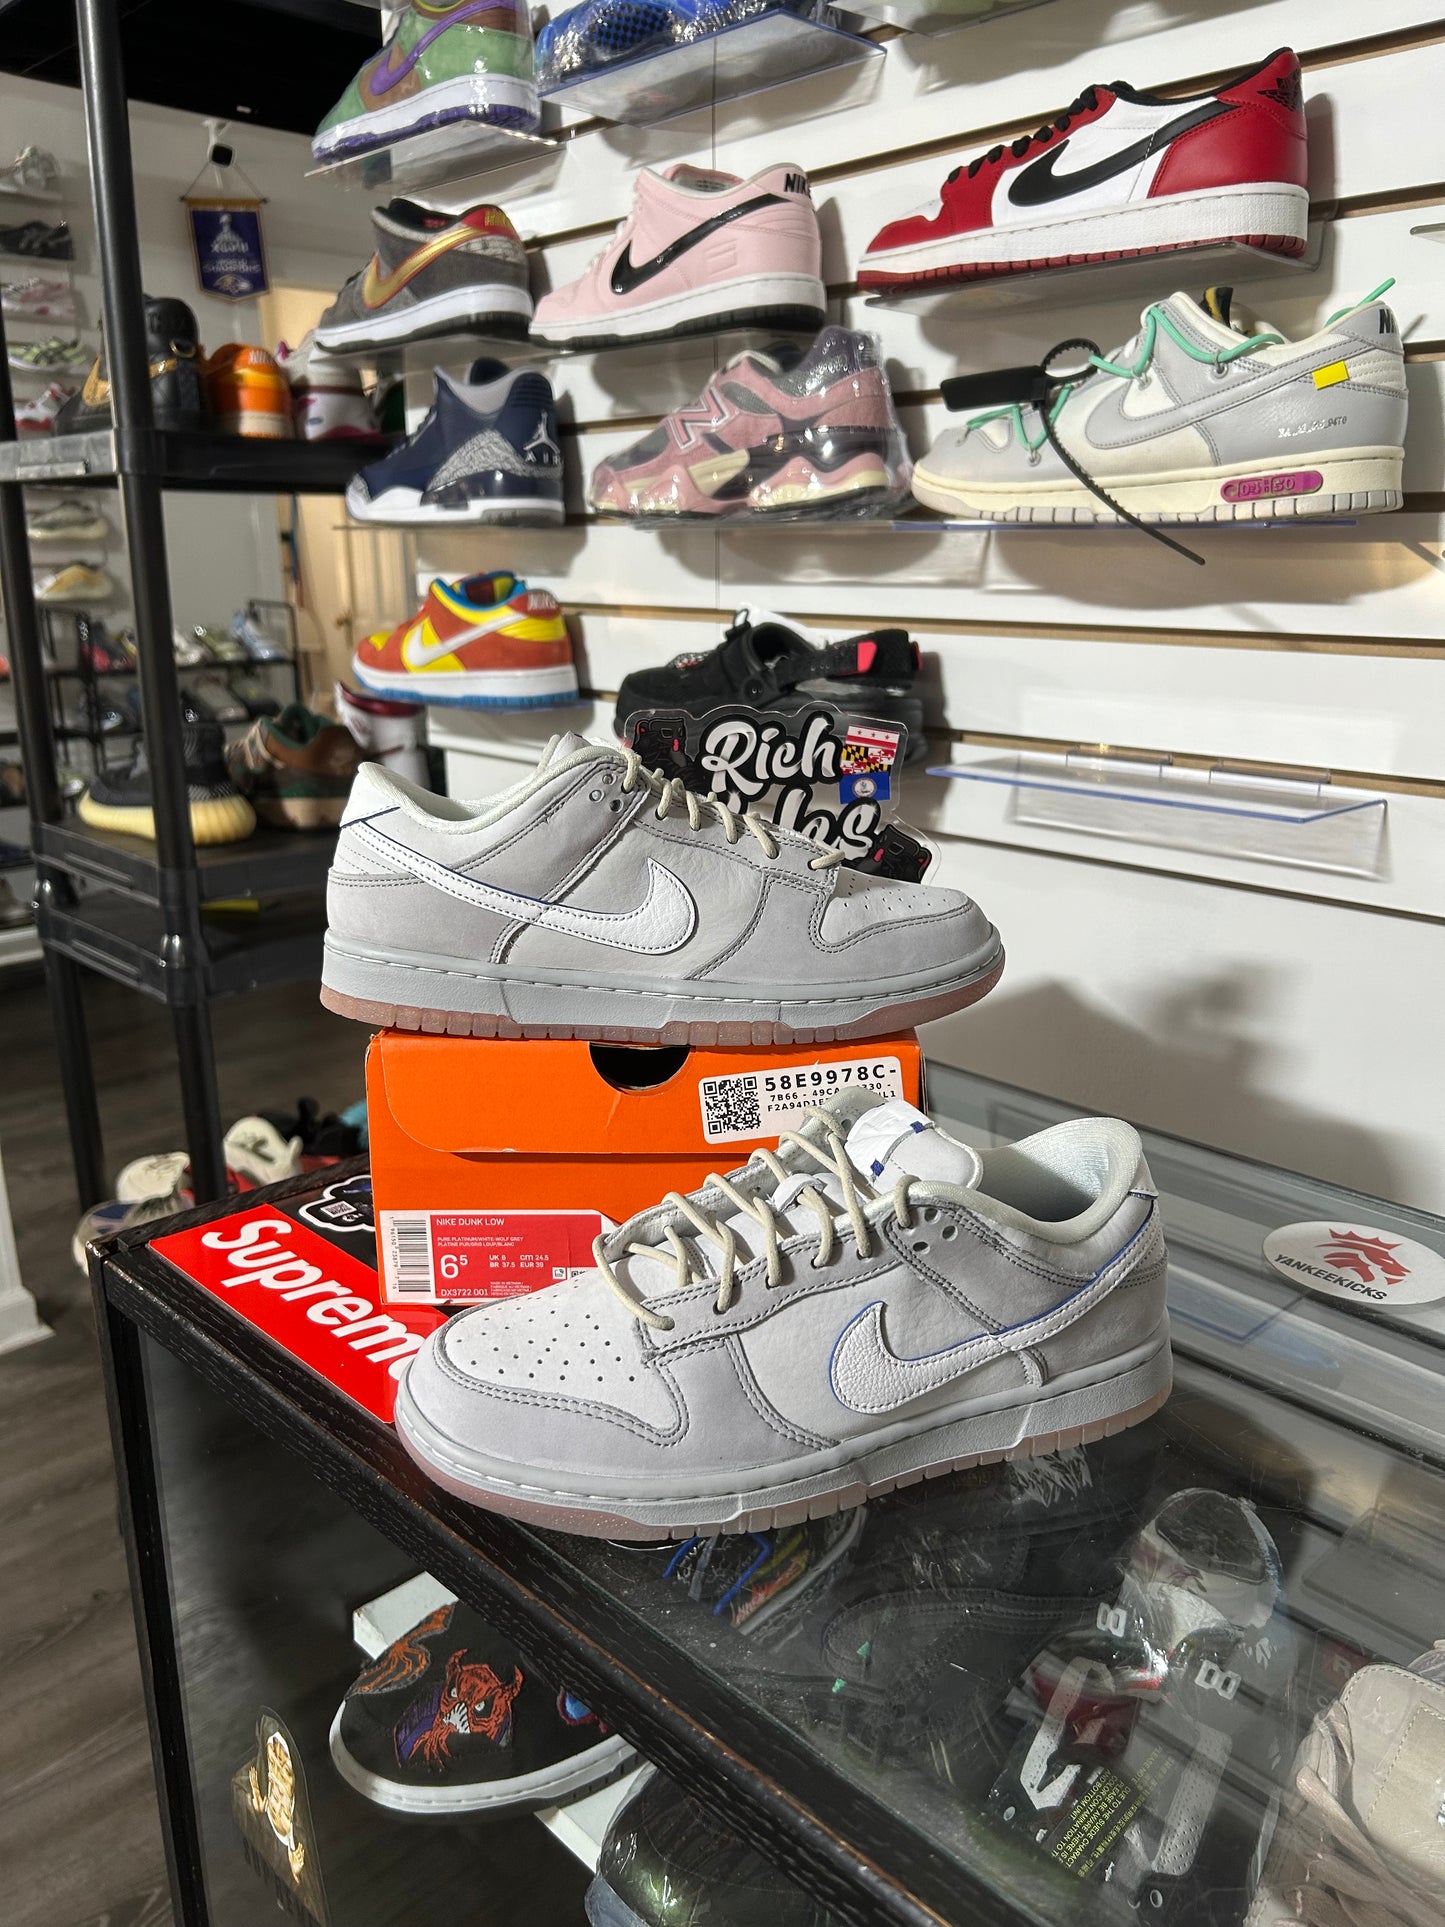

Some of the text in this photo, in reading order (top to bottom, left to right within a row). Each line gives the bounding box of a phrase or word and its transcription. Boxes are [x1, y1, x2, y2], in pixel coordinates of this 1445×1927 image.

[784, 173, 811, 198] NIK
[701, 717, 836, 796] Rich
[765, 1064, 896, 1091] 58E9978C-
[767, 1097, 829, 1112] F2A94D1E
[770, 1092, 798, 1102] 7B66
[812, 1087, 839, 1098] 49CA
[436, 1217, 505, 1226] NIKE DUNK LOW
[1274, 1254, 1388, 1300] YANKEEKICKS
[1079, 1780, 1102, 1806] BOTTOM
[1098, 1773, 1118, 1796] COLOR
[1117, 1785, 1131, 1800] DUE
[1101, 1806, 1114, 1820] THE
[1110, 1797, 1121, 1809] TO
[1059, 1779, 1125, 1859] PLEASE BE AWARE THERE IS
[1086, 1817, 1105, 1839] SUEDE
[1055, 1839, 1066, 1851] TO
[1063, 1837, 1090, 1867] CHARACT
